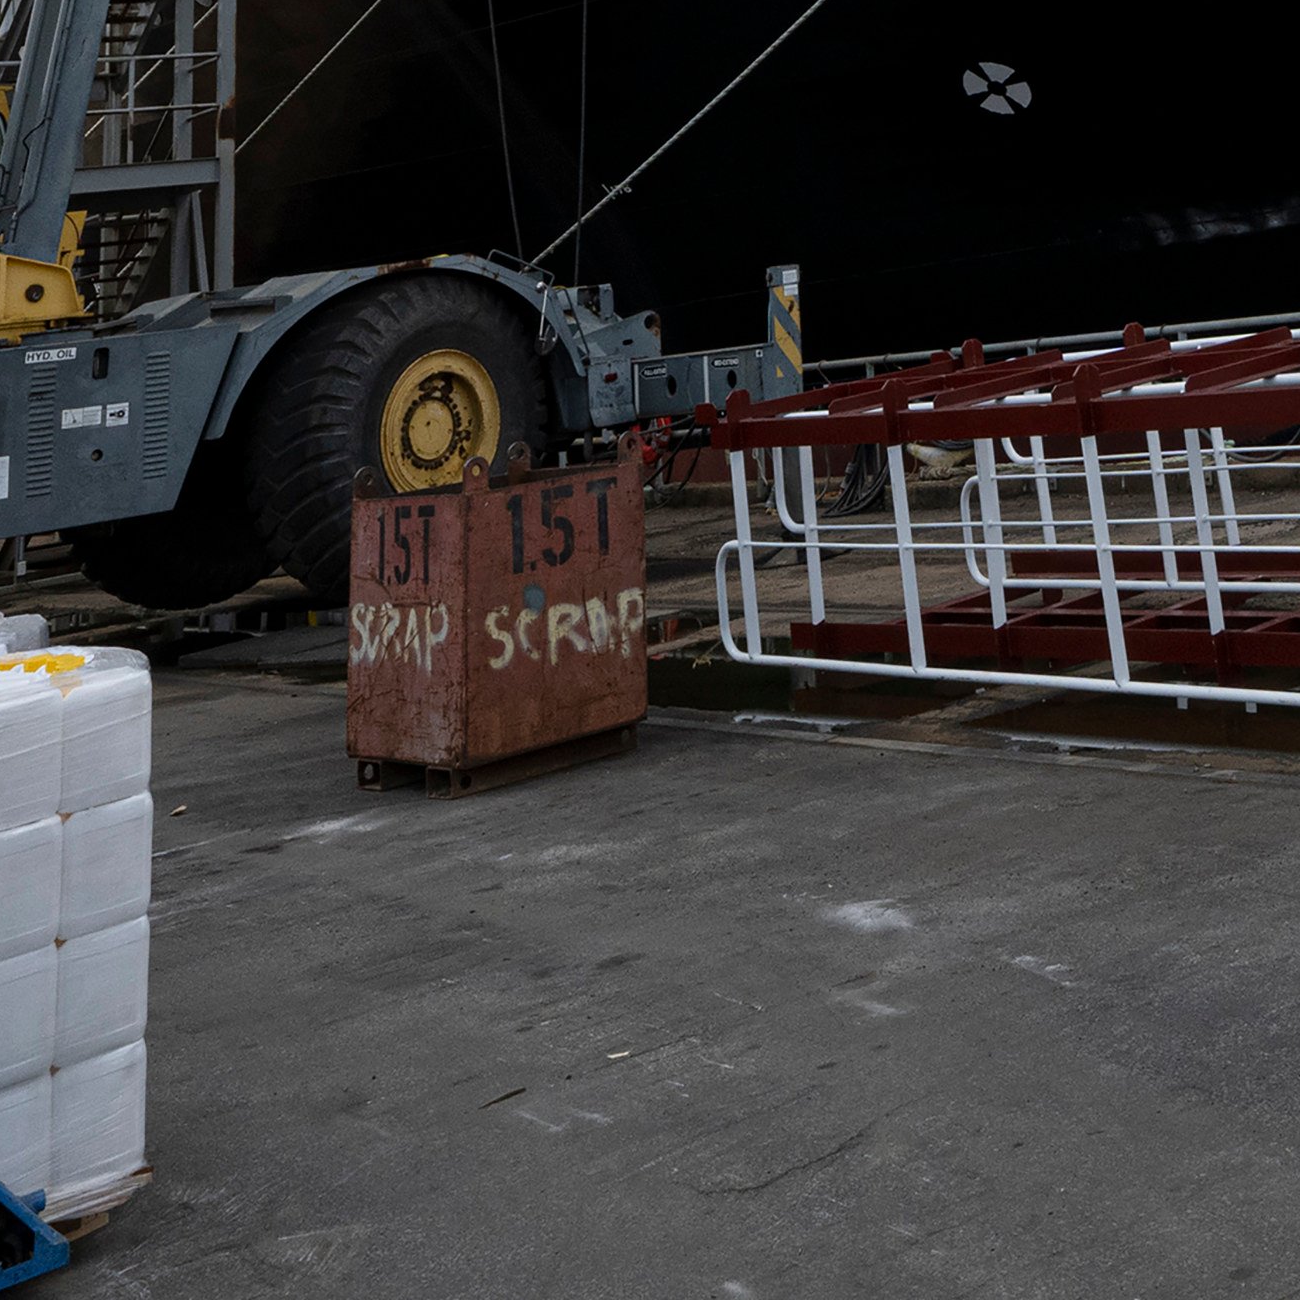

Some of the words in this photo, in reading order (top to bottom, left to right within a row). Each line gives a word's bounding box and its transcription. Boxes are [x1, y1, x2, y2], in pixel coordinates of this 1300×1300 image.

[26, 351, 54, 362] HYD.
[56, 349, 75, 359] OIL
[506, 477, 618, 575] 1.5T
[351, 601, 449, 676] SCRAP
[485, 587, 644, 669] SCRAP
